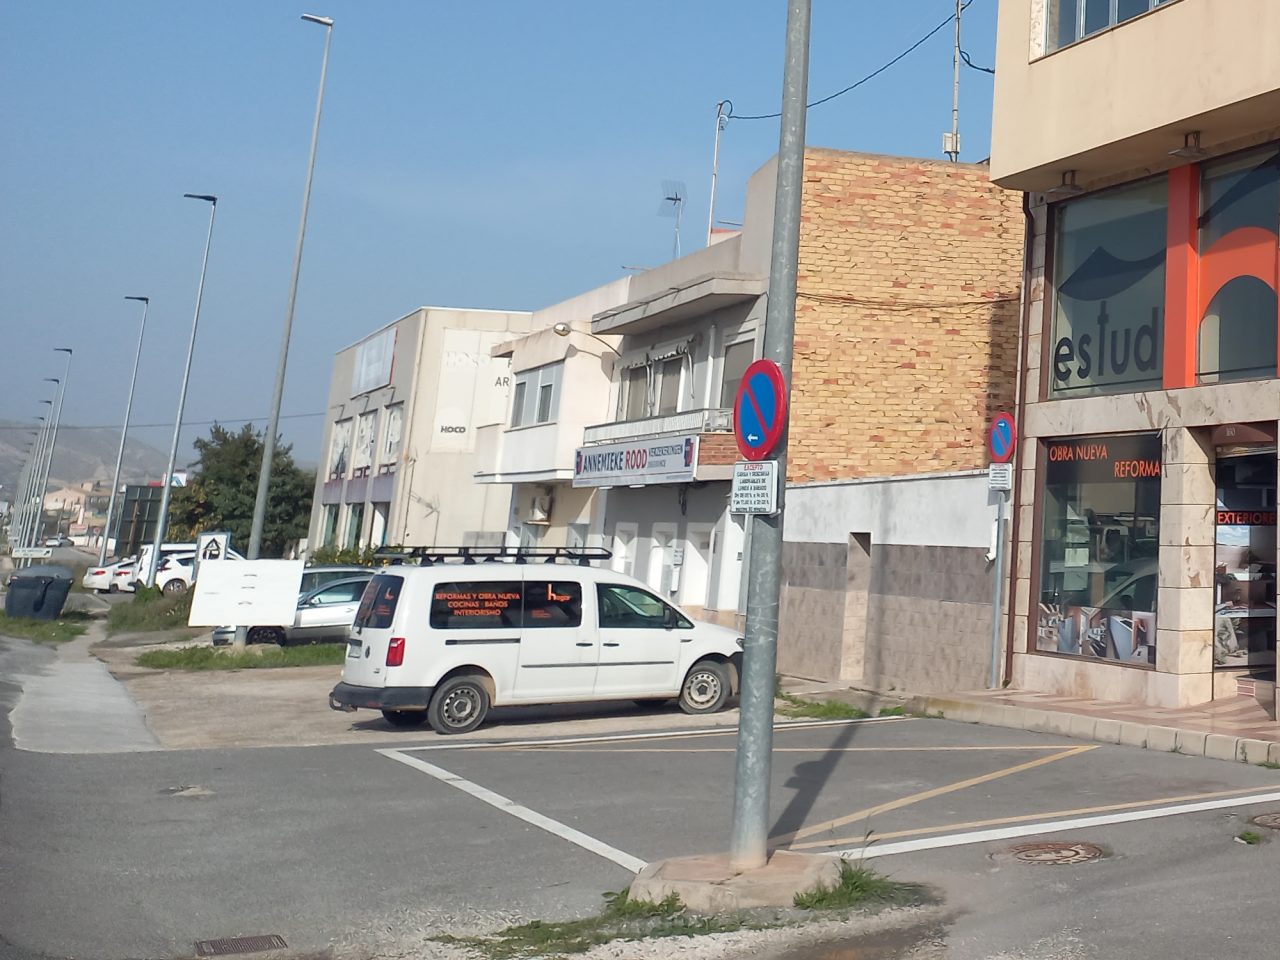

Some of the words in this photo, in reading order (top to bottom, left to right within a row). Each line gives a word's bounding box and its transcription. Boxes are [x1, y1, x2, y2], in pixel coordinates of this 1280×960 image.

[583, 451, 624, 473] ANNEMIEKE
[625, 448, 648, 470] ROOD
[1049, 445, 1074, 462] OBRA
[1075, 444, 1108, 460] NUEVA
